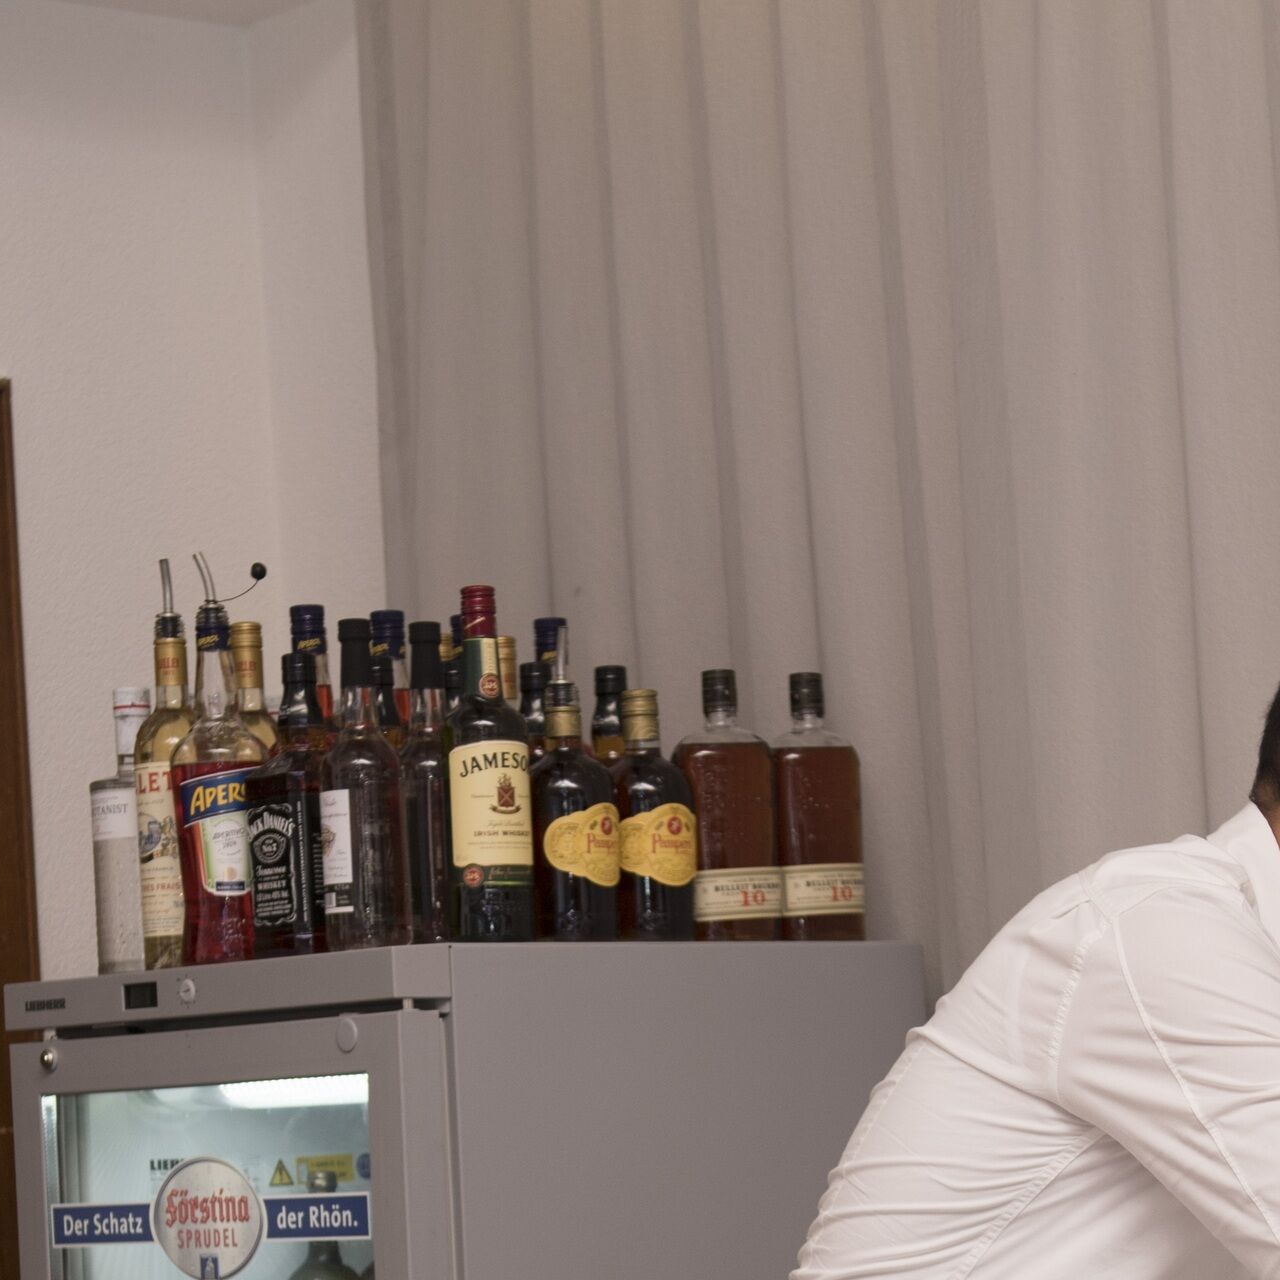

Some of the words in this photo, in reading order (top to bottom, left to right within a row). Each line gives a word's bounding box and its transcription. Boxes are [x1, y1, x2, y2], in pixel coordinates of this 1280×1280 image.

[459, 751, 529, 778] JAMESO
[136, 770, 172, 794] LET
[190, 782, 247, 816] APER
[473, 828, 500, 838] IRISH
[740, 890, 766, 907] 10
[831, 886, 853, 902] 10
[25, 998, 66, 1012] LIEBHERR
[150, 1159, 182, 1171] LIE
[63, 1215, 88, 1236] Der
[94, 1212, 144, 1236] Schatz
[276, 1208, 305, 1230] der
[309, 1202, 359, 1228] Rhön.
[177, 1228, 238, 1249] SPRUDEL
